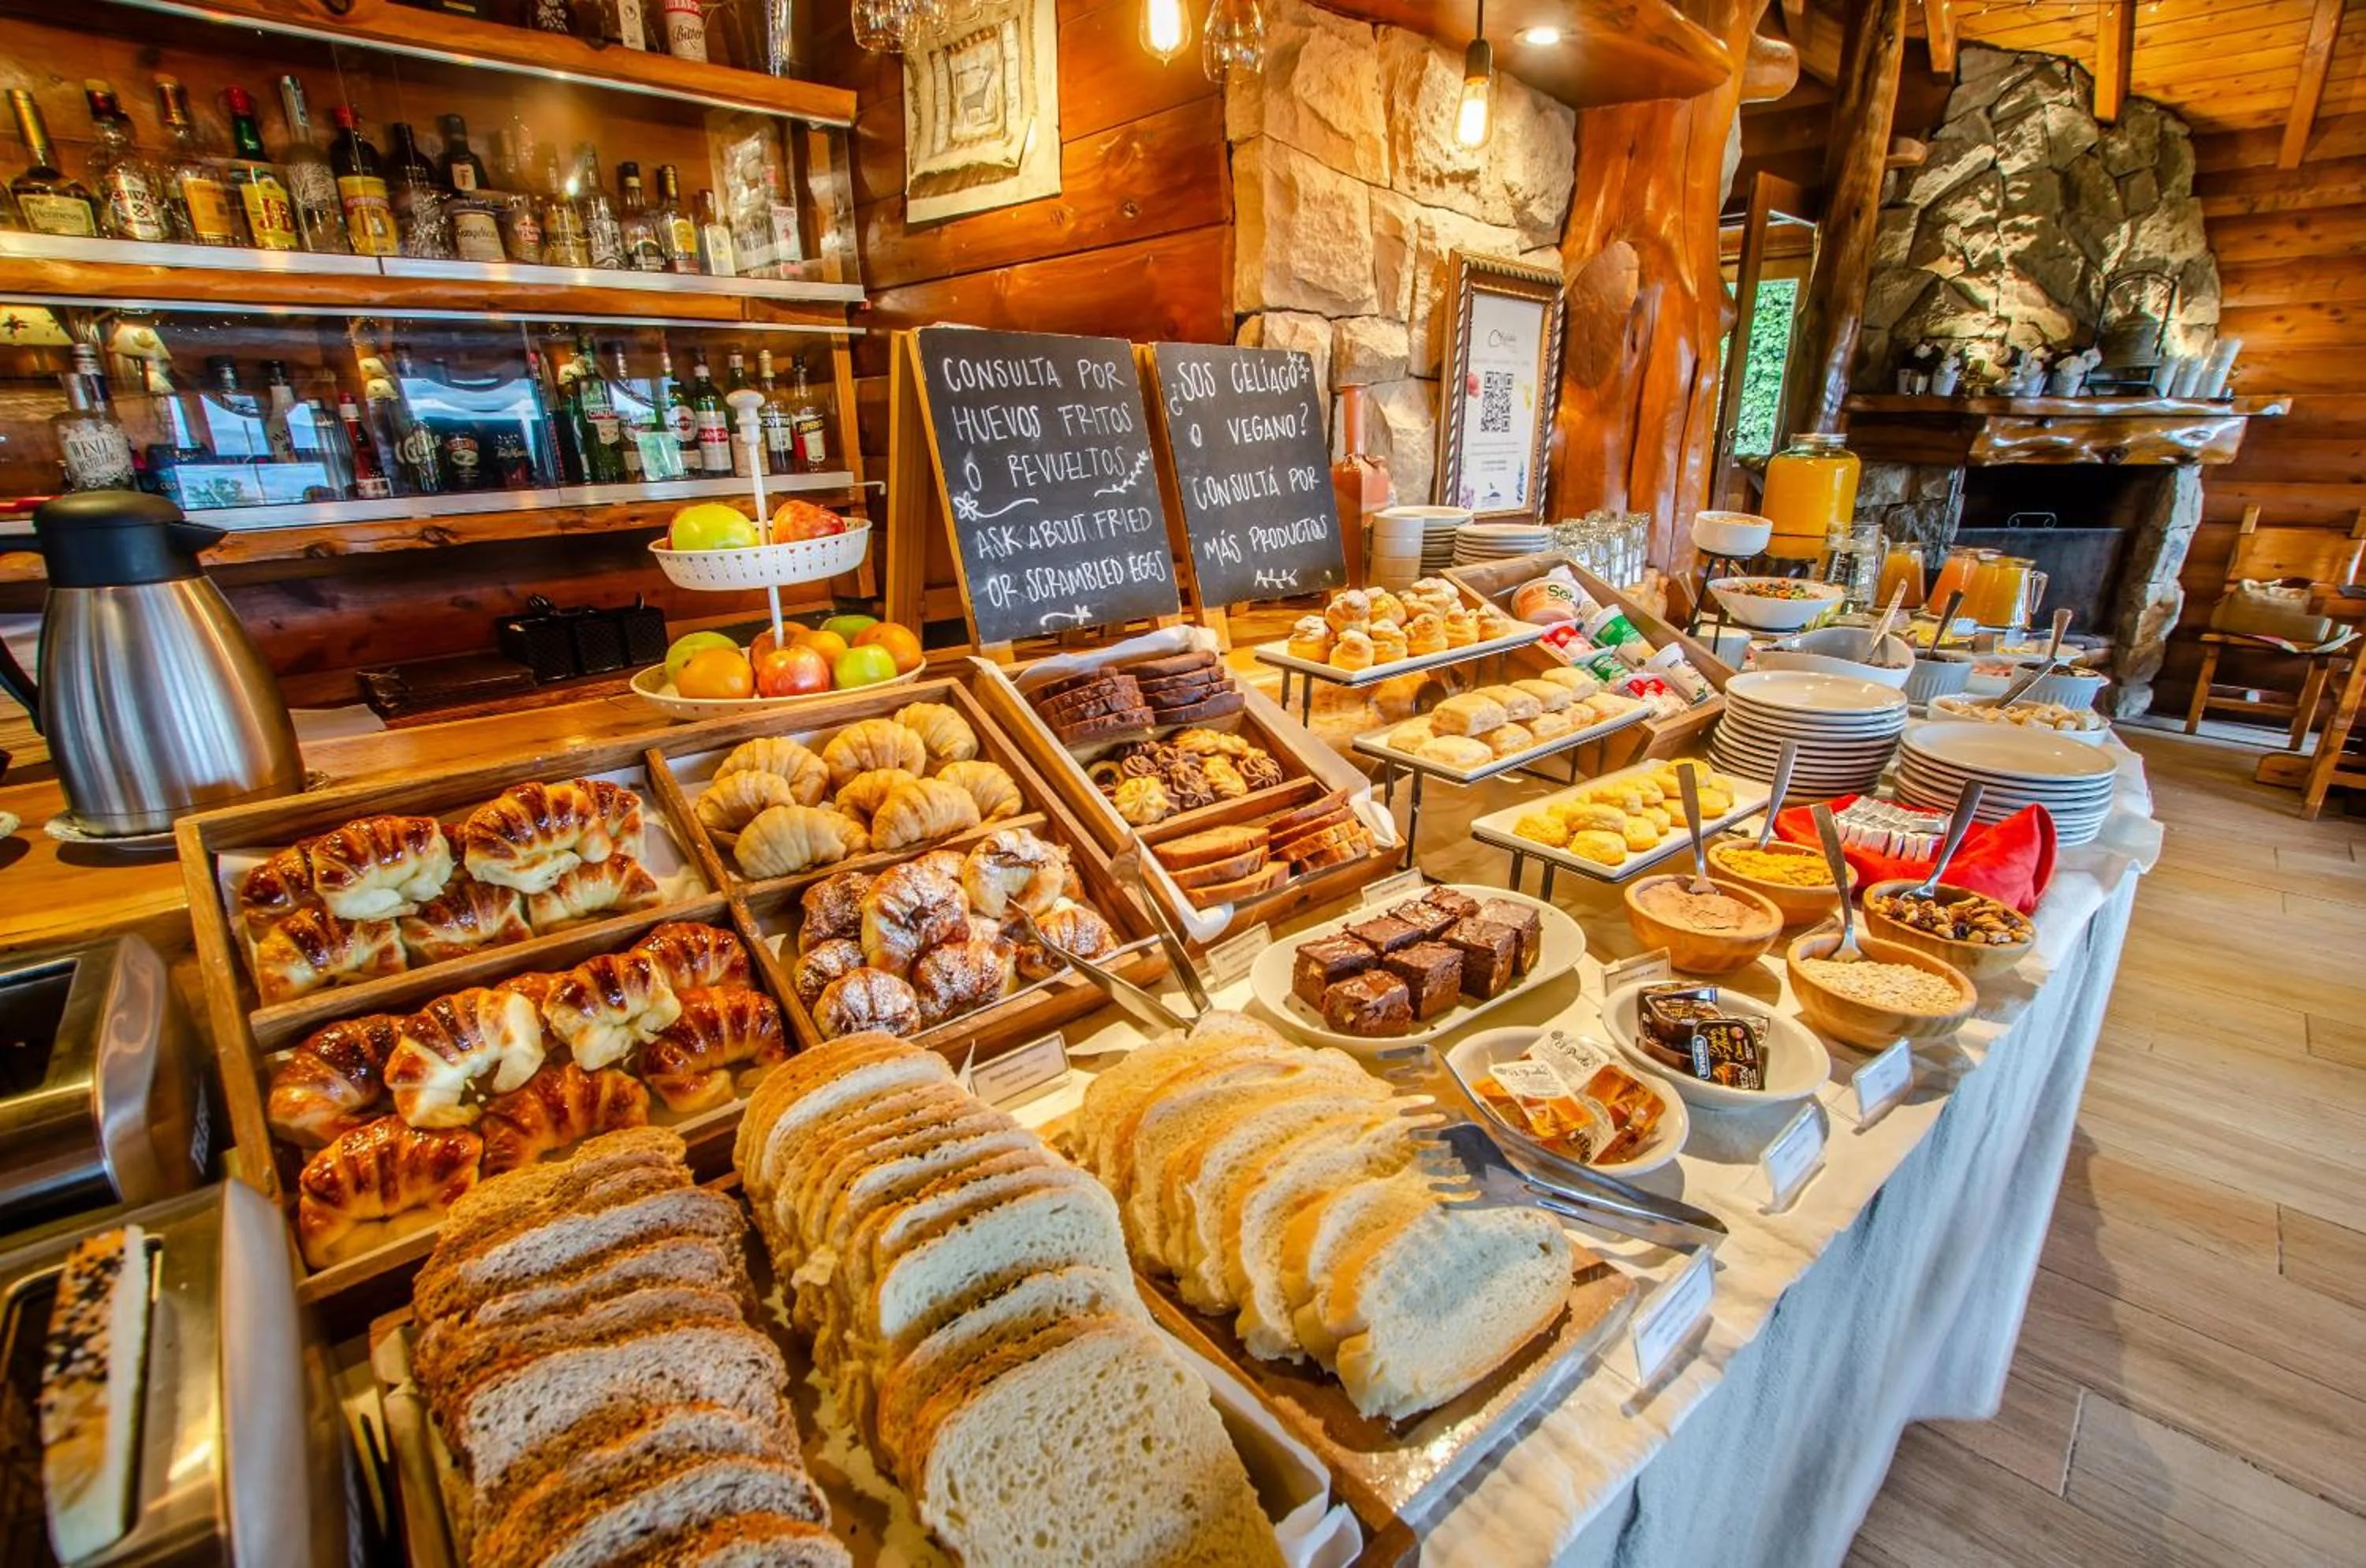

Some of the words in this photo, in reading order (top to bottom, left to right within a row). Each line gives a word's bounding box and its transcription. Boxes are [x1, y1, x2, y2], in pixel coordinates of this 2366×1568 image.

[944, 357, 1061, 392] CONSULTA
[1077, 359, 1127, 391] POR
[951, 405, 1042, 445] HUEVOS
[1058, 402, 1133, 438] FRITOS
[1190, 424, 1203, 448] O
[1227, 402, 1309, 446] VEGANO?
[965, 461, 983, 491] O
[1007, 446, 1127, 488] REVUELTOS
[1289, 466, 1321, 494] POR
[976, 524, 1023, 561] ASK
[1028, 513, 1087, 551] ABOUT
[1095, 507, 1153, 540] FRIED
[1204, 529, 1243, 567] MÁS
[1248, 514, 1328, 553] PRODUCTOS
[987, 573, 1021, 609] OR
[1025, 558, 1125, 603] SCRAMBLED
[1129, 550, 1167, 583] EGGS
